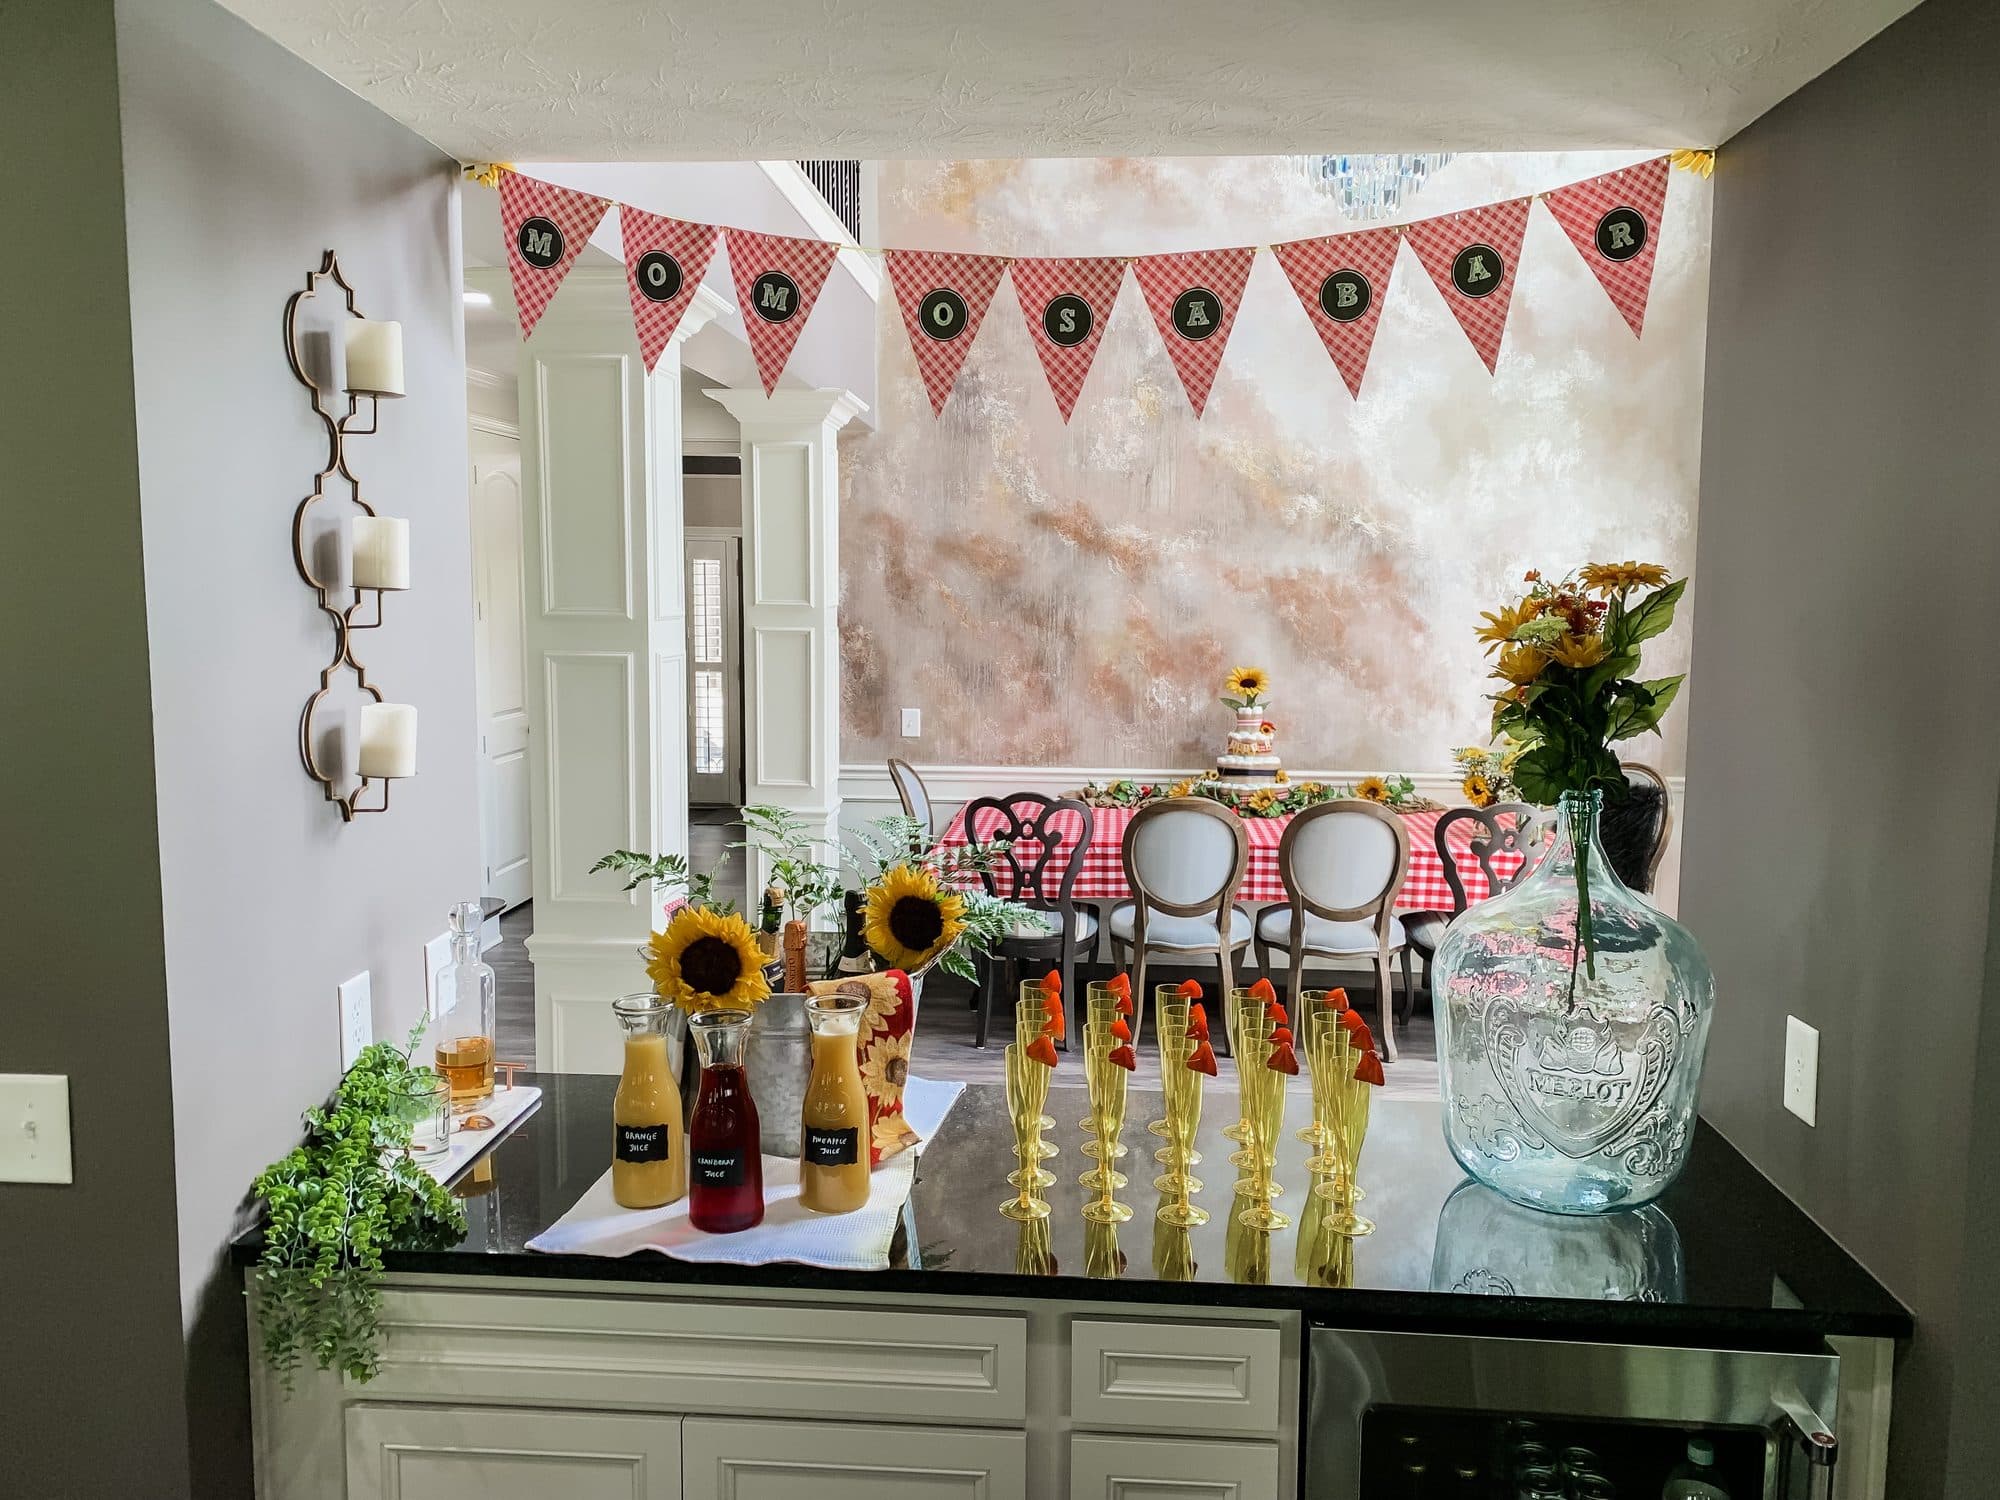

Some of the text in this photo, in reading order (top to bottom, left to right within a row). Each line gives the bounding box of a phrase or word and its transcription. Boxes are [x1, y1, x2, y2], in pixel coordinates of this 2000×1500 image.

[1526, 1069, 1632, 1102] MERLOT
[625, 1131, 657, 1141] ORANGE
[812, 1135, 848, 1145] PINEAPPLE
[629, 1143, 649, 1152] JUICE
[820, 1147, 840, 1155] JUICE
[697, 1157, 735, 1166] CRANBERRY
[704, 1170, 725, 1178] JUICE
